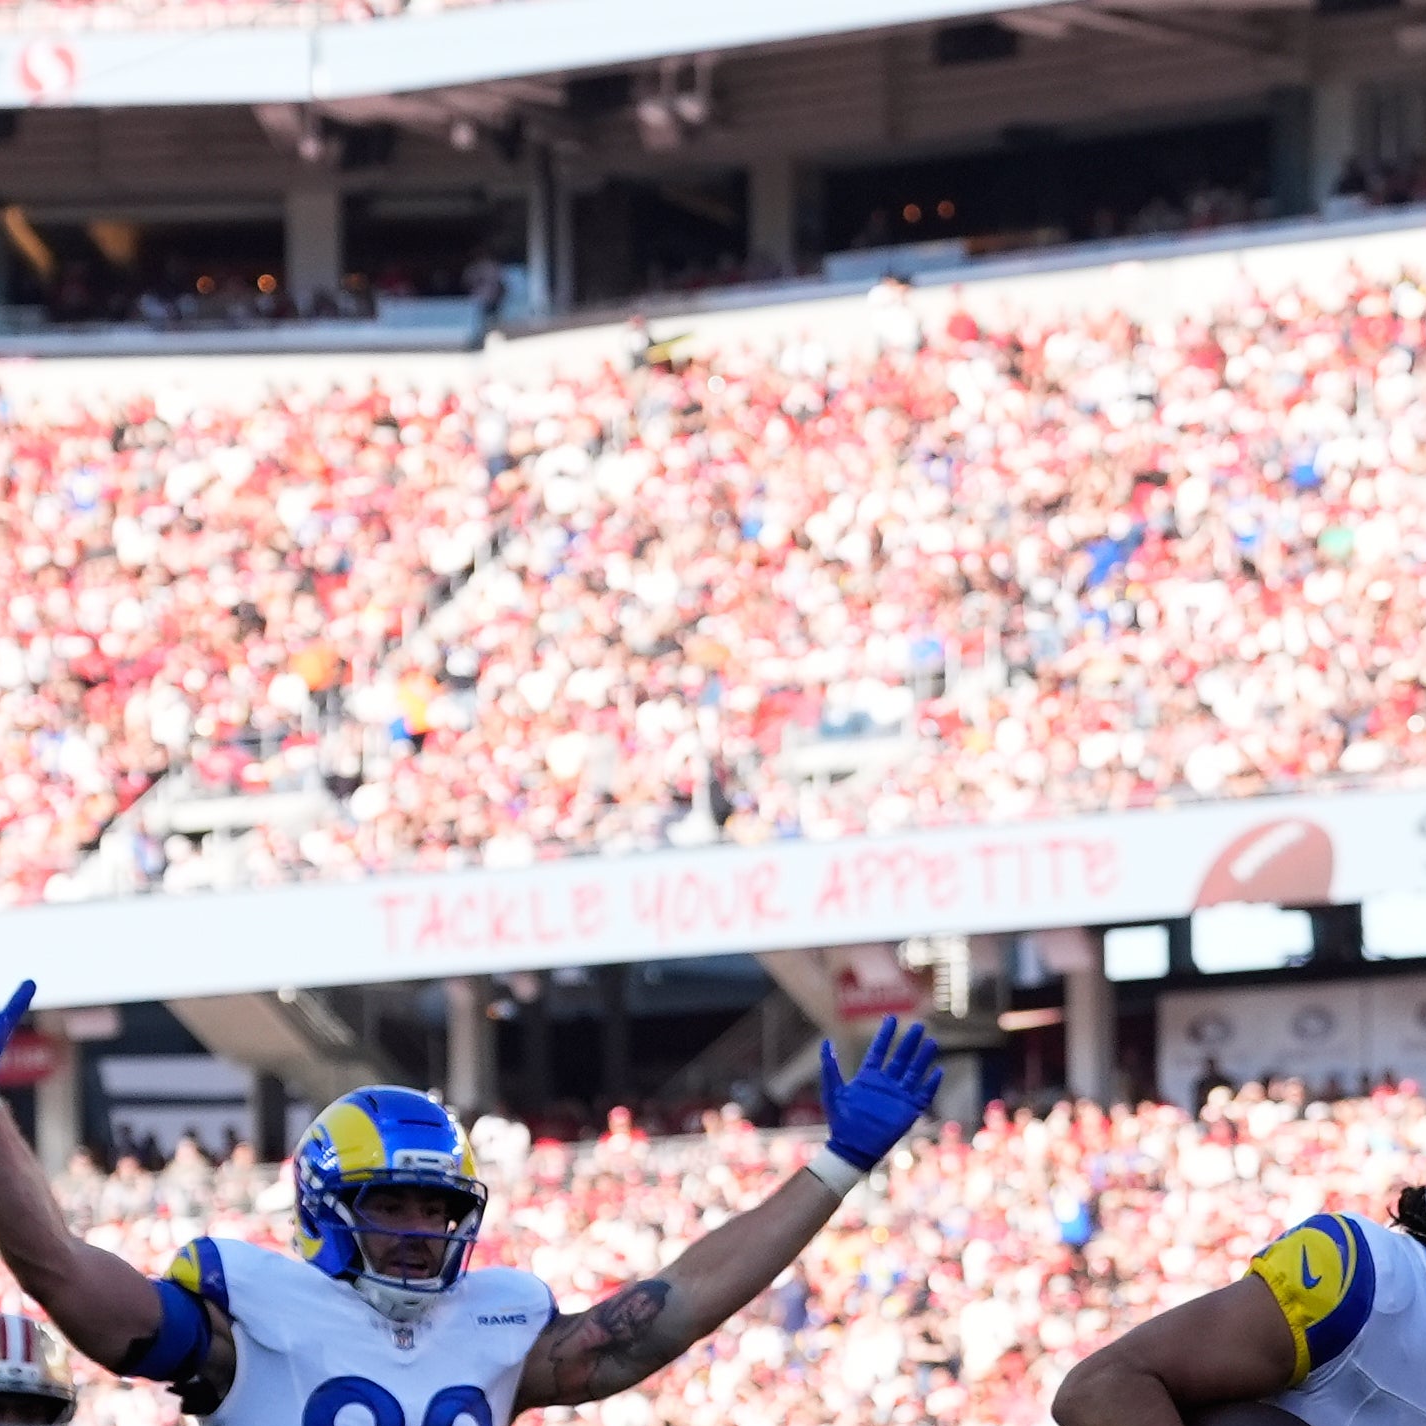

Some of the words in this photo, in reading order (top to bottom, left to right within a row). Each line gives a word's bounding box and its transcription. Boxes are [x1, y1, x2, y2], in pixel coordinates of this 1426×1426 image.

[377, 882, 607, 948] TACKLE
[631, 860, 789, 938] YOUR
[813, 836, 1120, 921] APPETITE
[476, 1313, 528, 1326] RAMS
